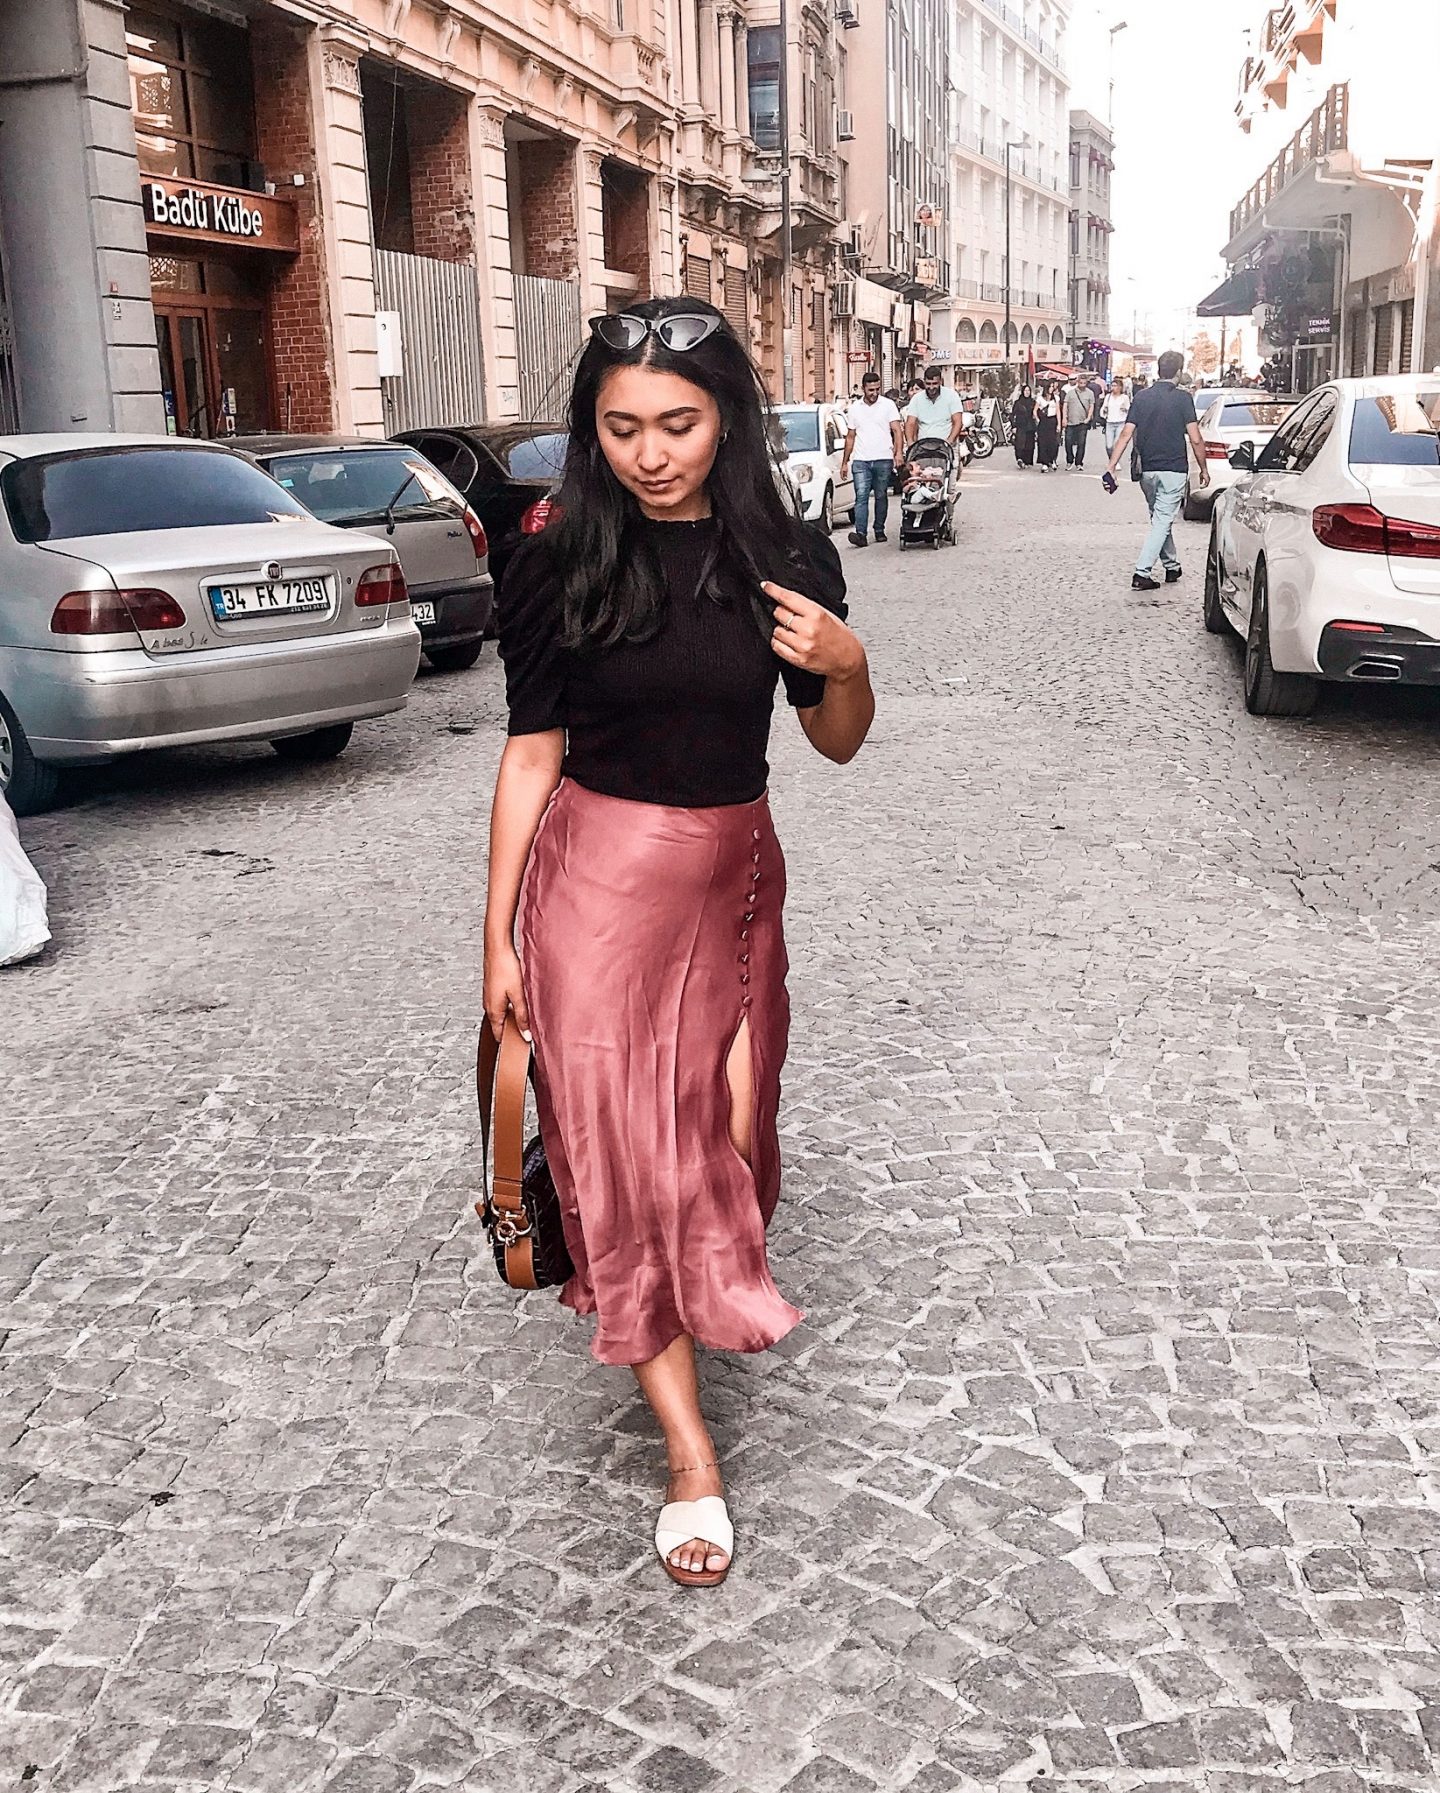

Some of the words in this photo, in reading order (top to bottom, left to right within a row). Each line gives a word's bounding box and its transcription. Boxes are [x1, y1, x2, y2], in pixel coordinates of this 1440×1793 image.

[151, 183, 208, 229] Badü
[212, 194, 263, 237] Kübe
[223, 588, 246, 611] 34
[255, 585, 279, 607] FK
[282, 580, 324, 604] 7209
[411, 604, 433, 620] 432
